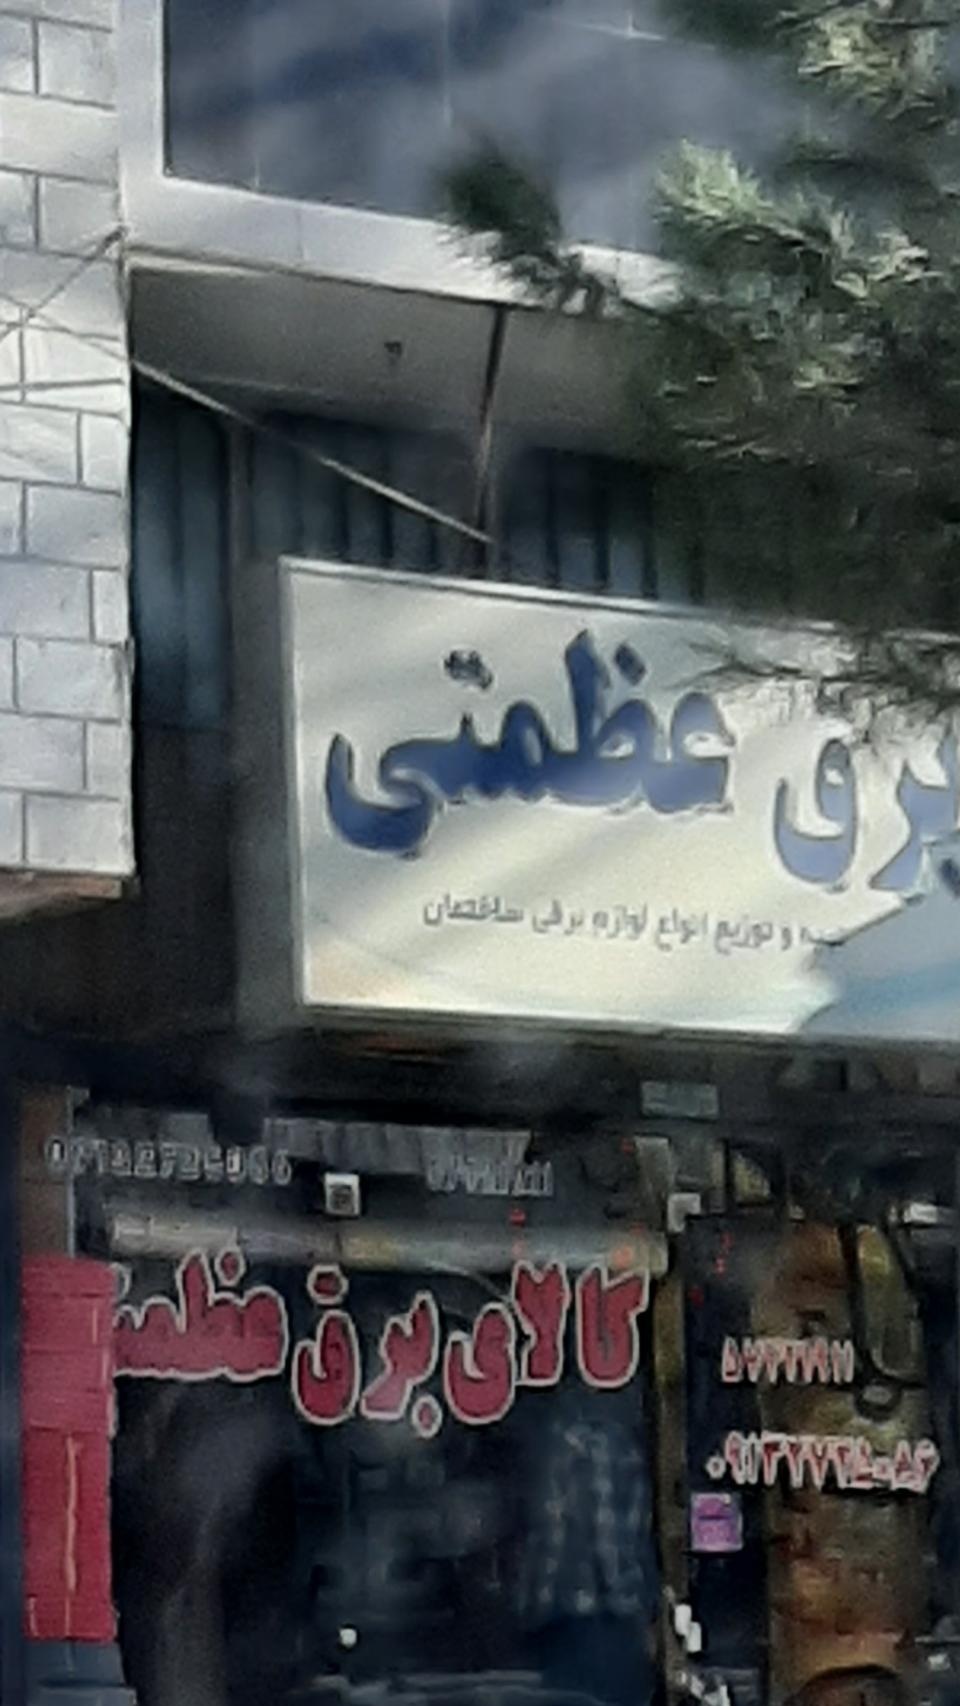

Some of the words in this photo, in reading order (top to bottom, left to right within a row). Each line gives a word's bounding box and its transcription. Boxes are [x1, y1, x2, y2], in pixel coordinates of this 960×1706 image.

[324, 628, 732, 858] عظمتی
[422, 893, 525, 928] ساختمان
[291, 1262, 441, 1440] برق
[443, 1260, 651, 1426] کالای
